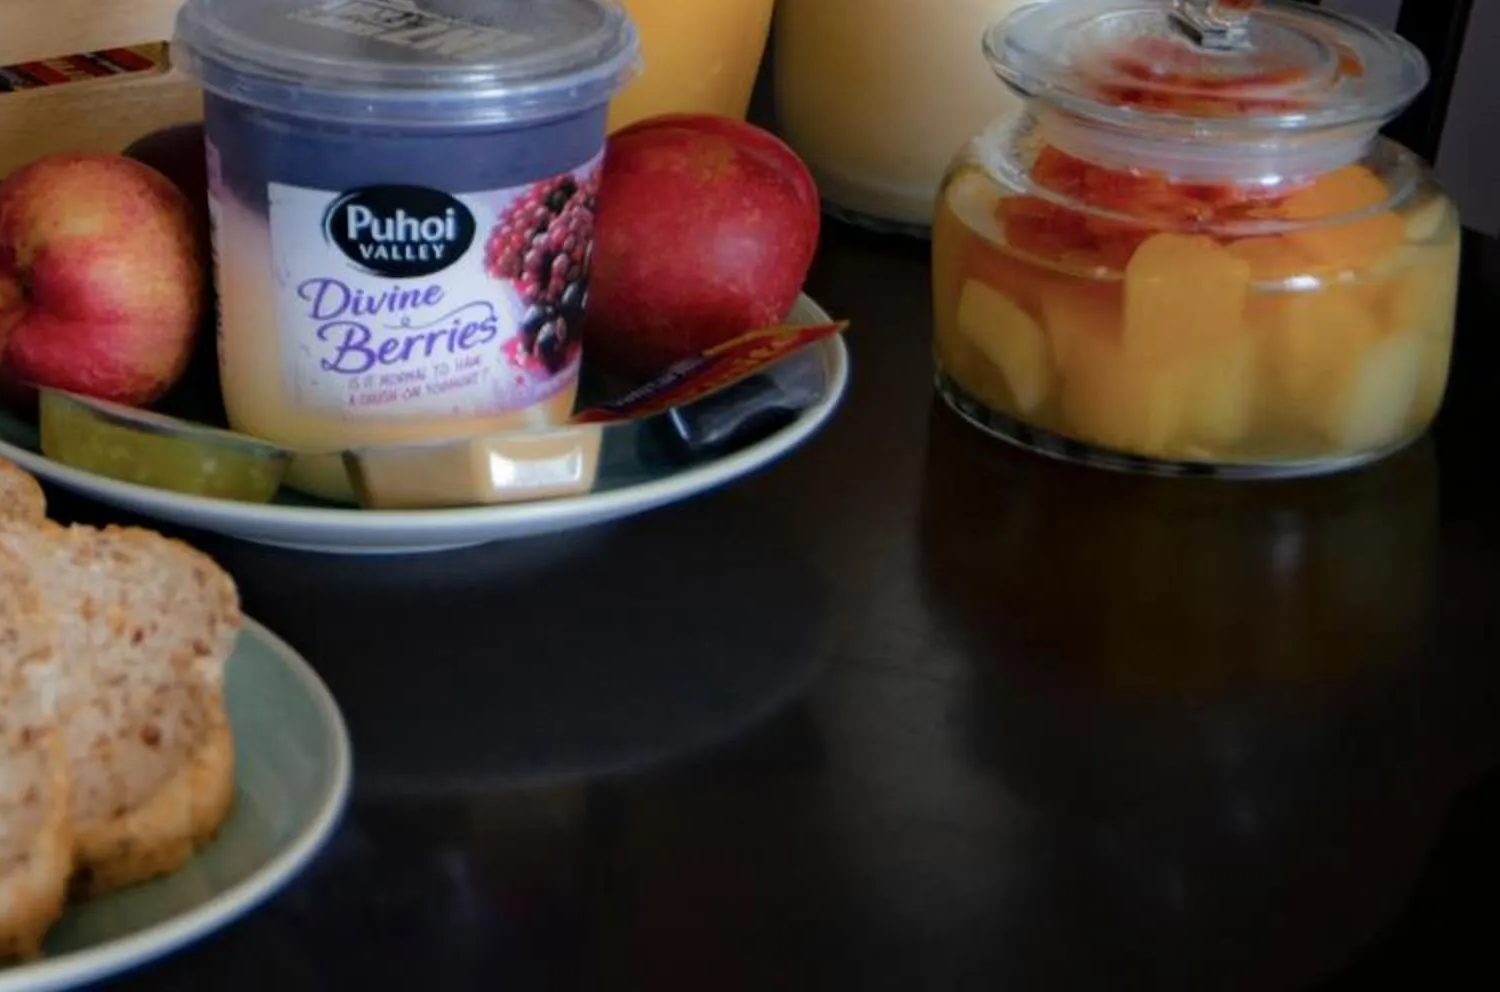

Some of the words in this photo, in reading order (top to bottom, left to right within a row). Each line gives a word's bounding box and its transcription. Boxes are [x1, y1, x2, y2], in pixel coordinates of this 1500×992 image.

[347, 204, 456, 244] Puhoi
[359, 244, 446, 261] VALLEY
[298, 277, 445, 320] Divine
[316, 313, 499, 374] Berries
